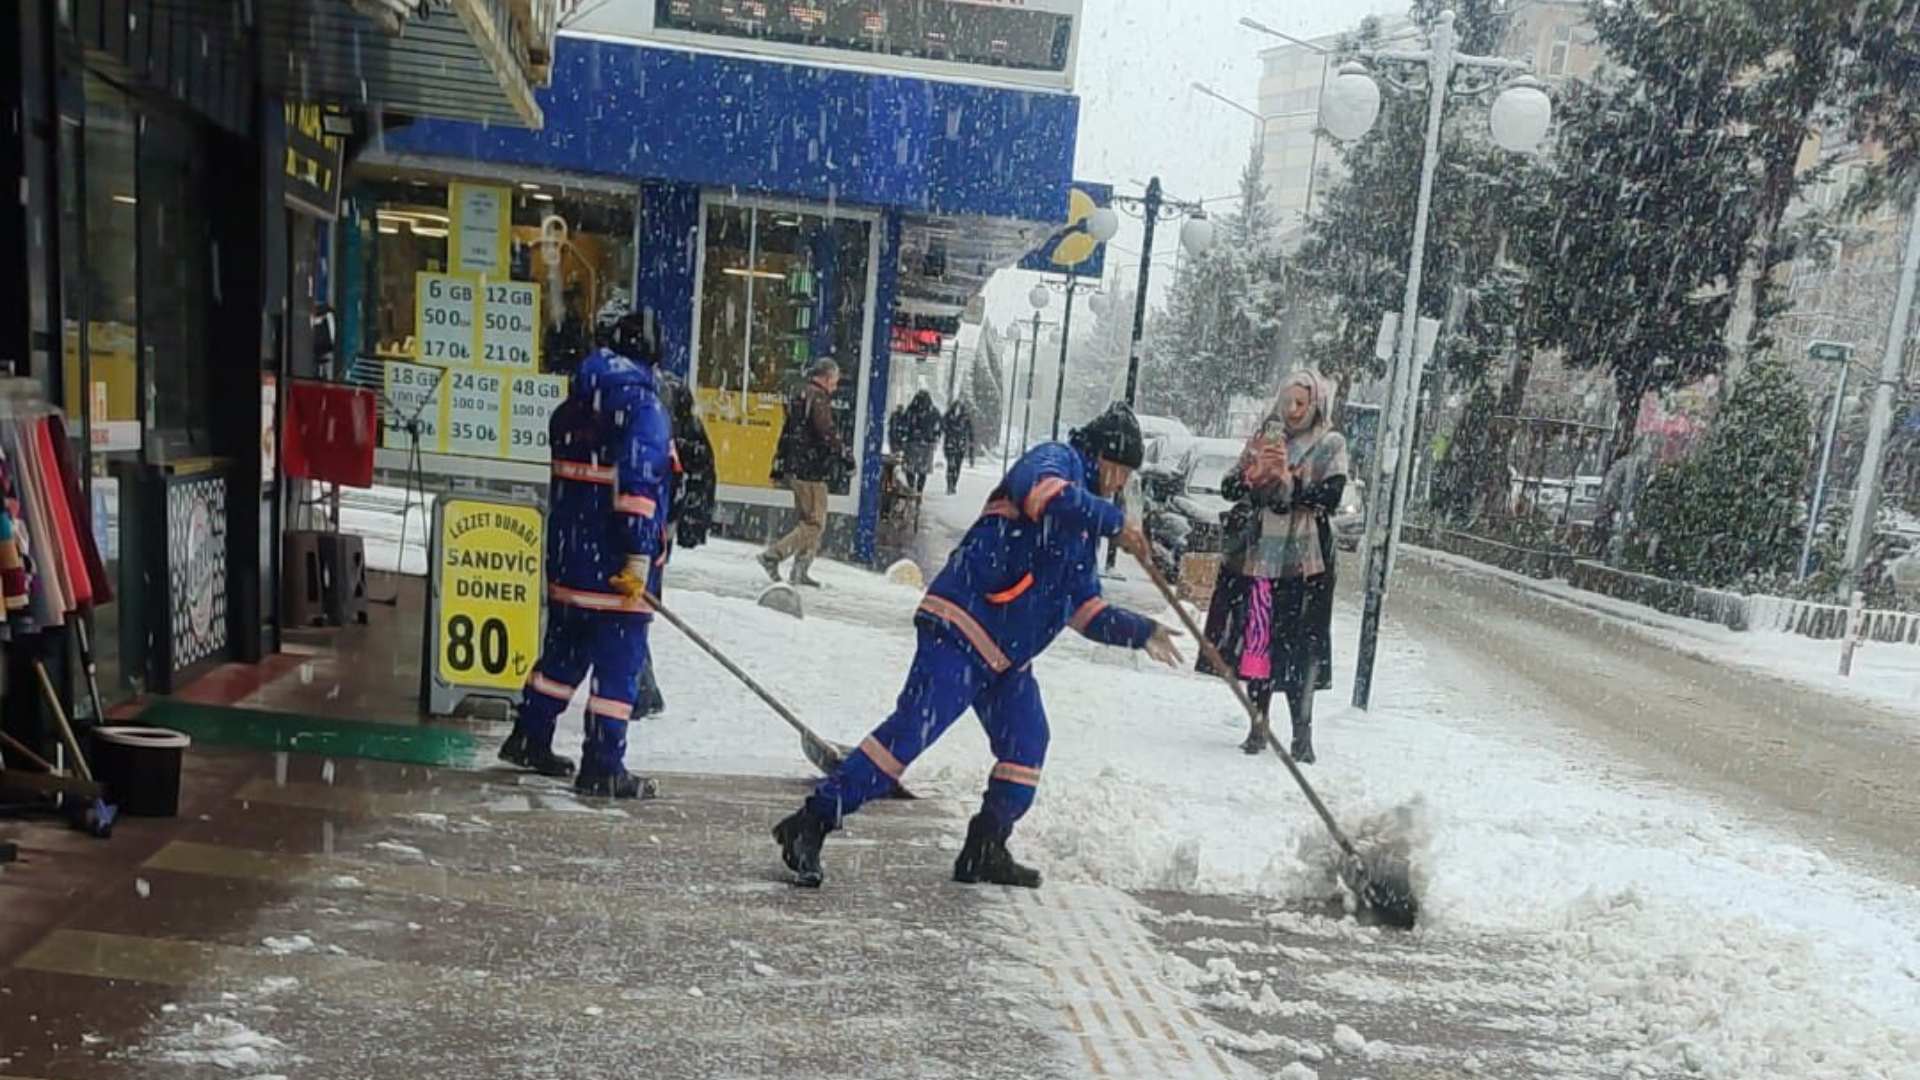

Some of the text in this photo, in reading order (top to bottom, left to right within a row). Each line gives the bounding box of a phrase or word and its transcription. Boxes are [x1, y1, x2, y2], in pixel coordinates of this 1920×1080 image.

[429, 280, 472, 301] 6 GB
[487, 287, 533, 306] 12 GB
[392, 367, 438, 387] 18 GB
[453, 373, 498, 392] 24 GB
[513, 379, 559, 398] 48 GB
[449, 513, 490, 539] LEZZET
[447, 548, 538, 575] SANDVİÇ
[457, 575, 526, 602] DÖNER
